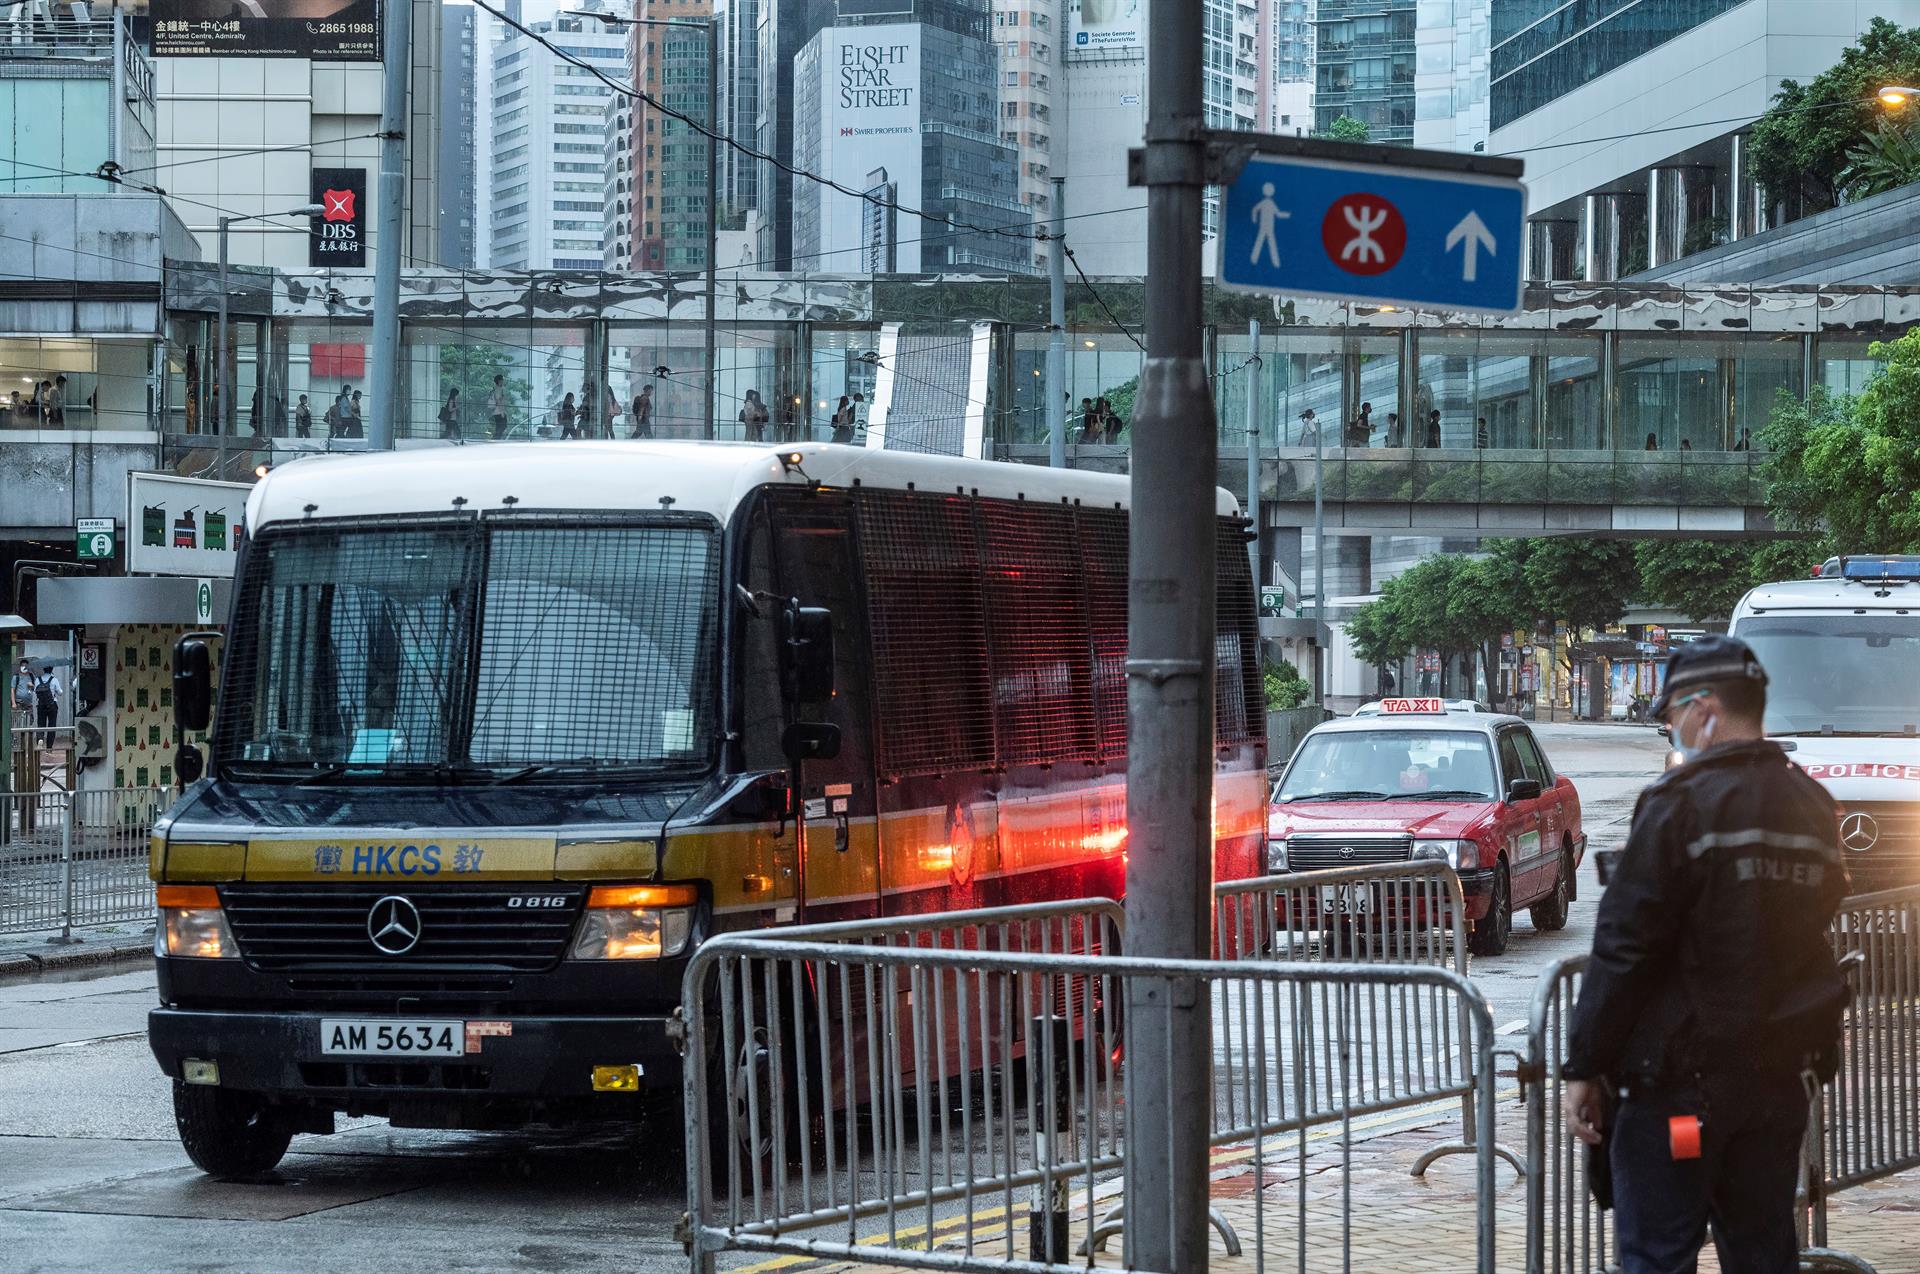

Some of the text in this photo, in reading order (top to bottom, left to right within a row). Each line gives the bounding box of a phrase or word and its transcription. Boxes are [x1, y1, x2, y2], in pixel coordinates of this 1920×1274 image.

[319, 23, 374, 33] 2865 1988
[841, 66, 893, 87] STAR
[841, 87, 913, 108] STREET
[875, 127, 913, 135] PROPERTIES
[322, 223, 356, 239] DBS
[1384, 699, 1438, 712] TAXI
[1807, 764, 1920, 780] POLICE
[352, 845, 442, 876] HKCS
[526, 897, 566, 907] 816
[330, 1026, 367, 1051] AM
[376, 1026, 454, 1052] 5634
